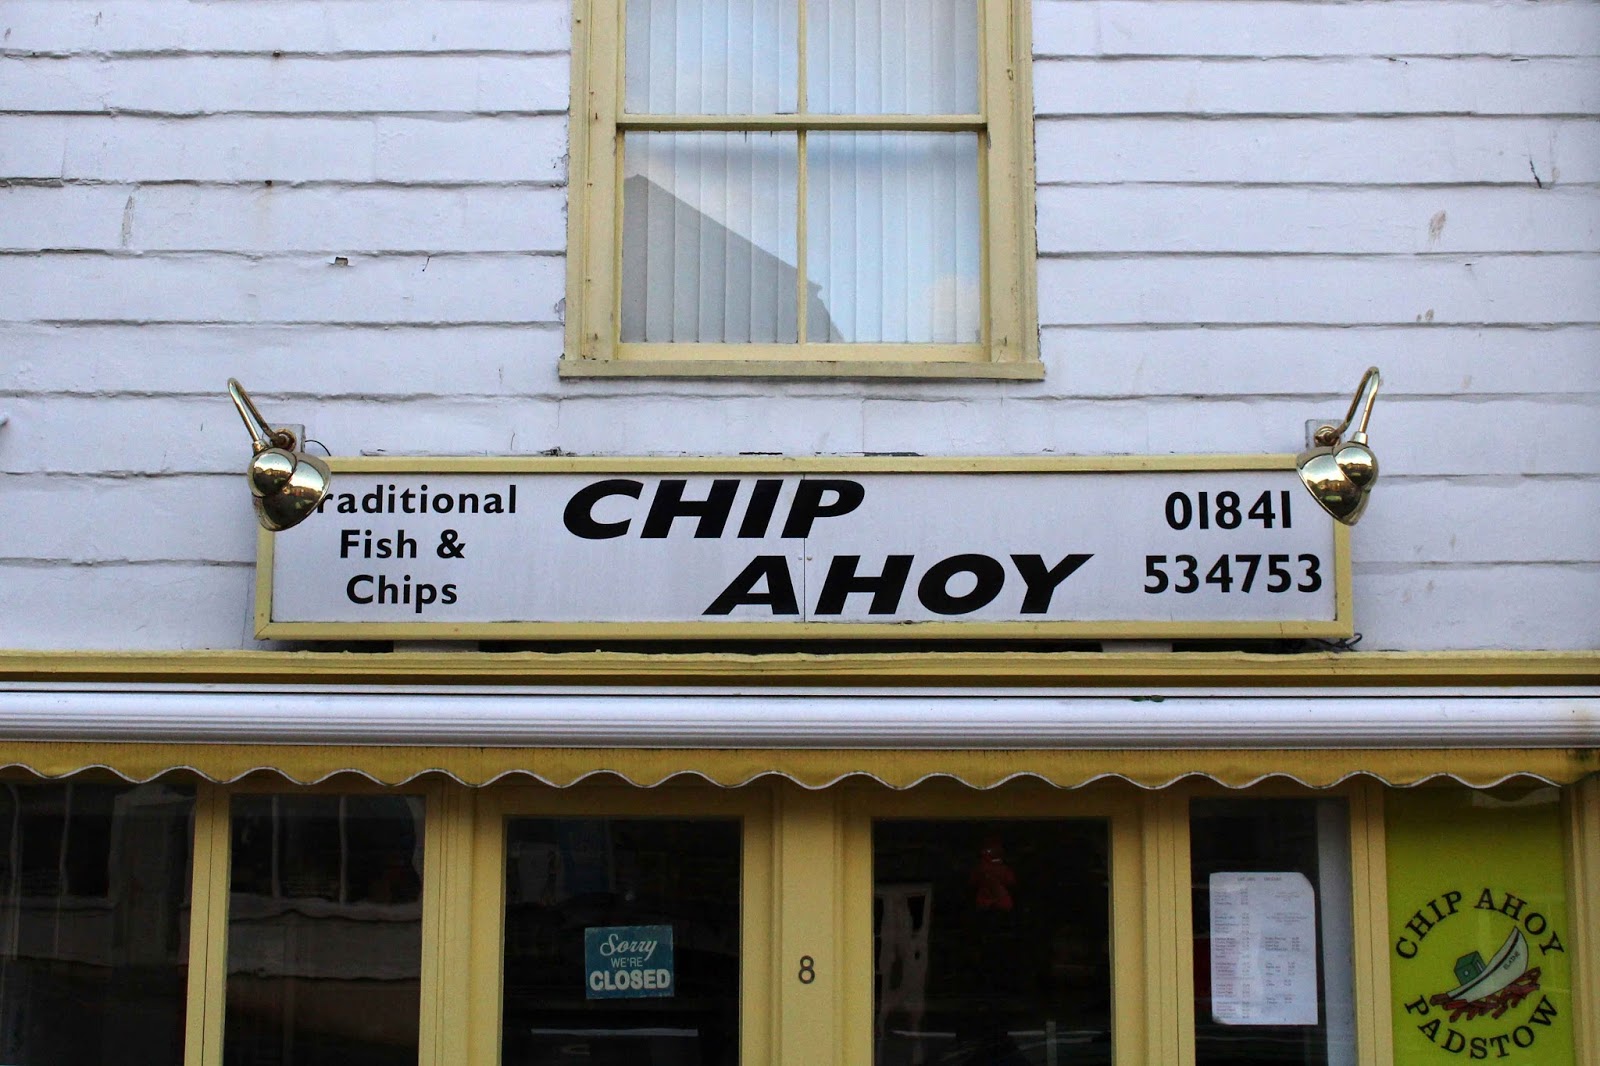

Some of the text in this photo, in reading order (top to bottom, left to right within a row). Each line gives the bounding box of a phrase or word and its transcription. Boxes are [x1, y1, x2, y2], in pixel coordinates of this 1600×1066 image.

[316, 484, 517, 514] raditional
[562, 478, 866, 540] CHIP
[1164, 490, 1292, 531] 01841
[339, 528, 466, 559] Fish &
[346, 574, 458, 614] Chips
[701, 553, 1095, 616] AHOY
[1143, 553, 1323, 595] 534753
[1395, 887, 1565, 960] CHIP AHOY
[599, 933, 658, 962] Sorry
[610, 956, 643, 968] WE'RE
[589, 968, 671, 991] CLOSED
[798, 955, 816, 985] 8
[1404, 994, 1558, 1060] PADSTOW
